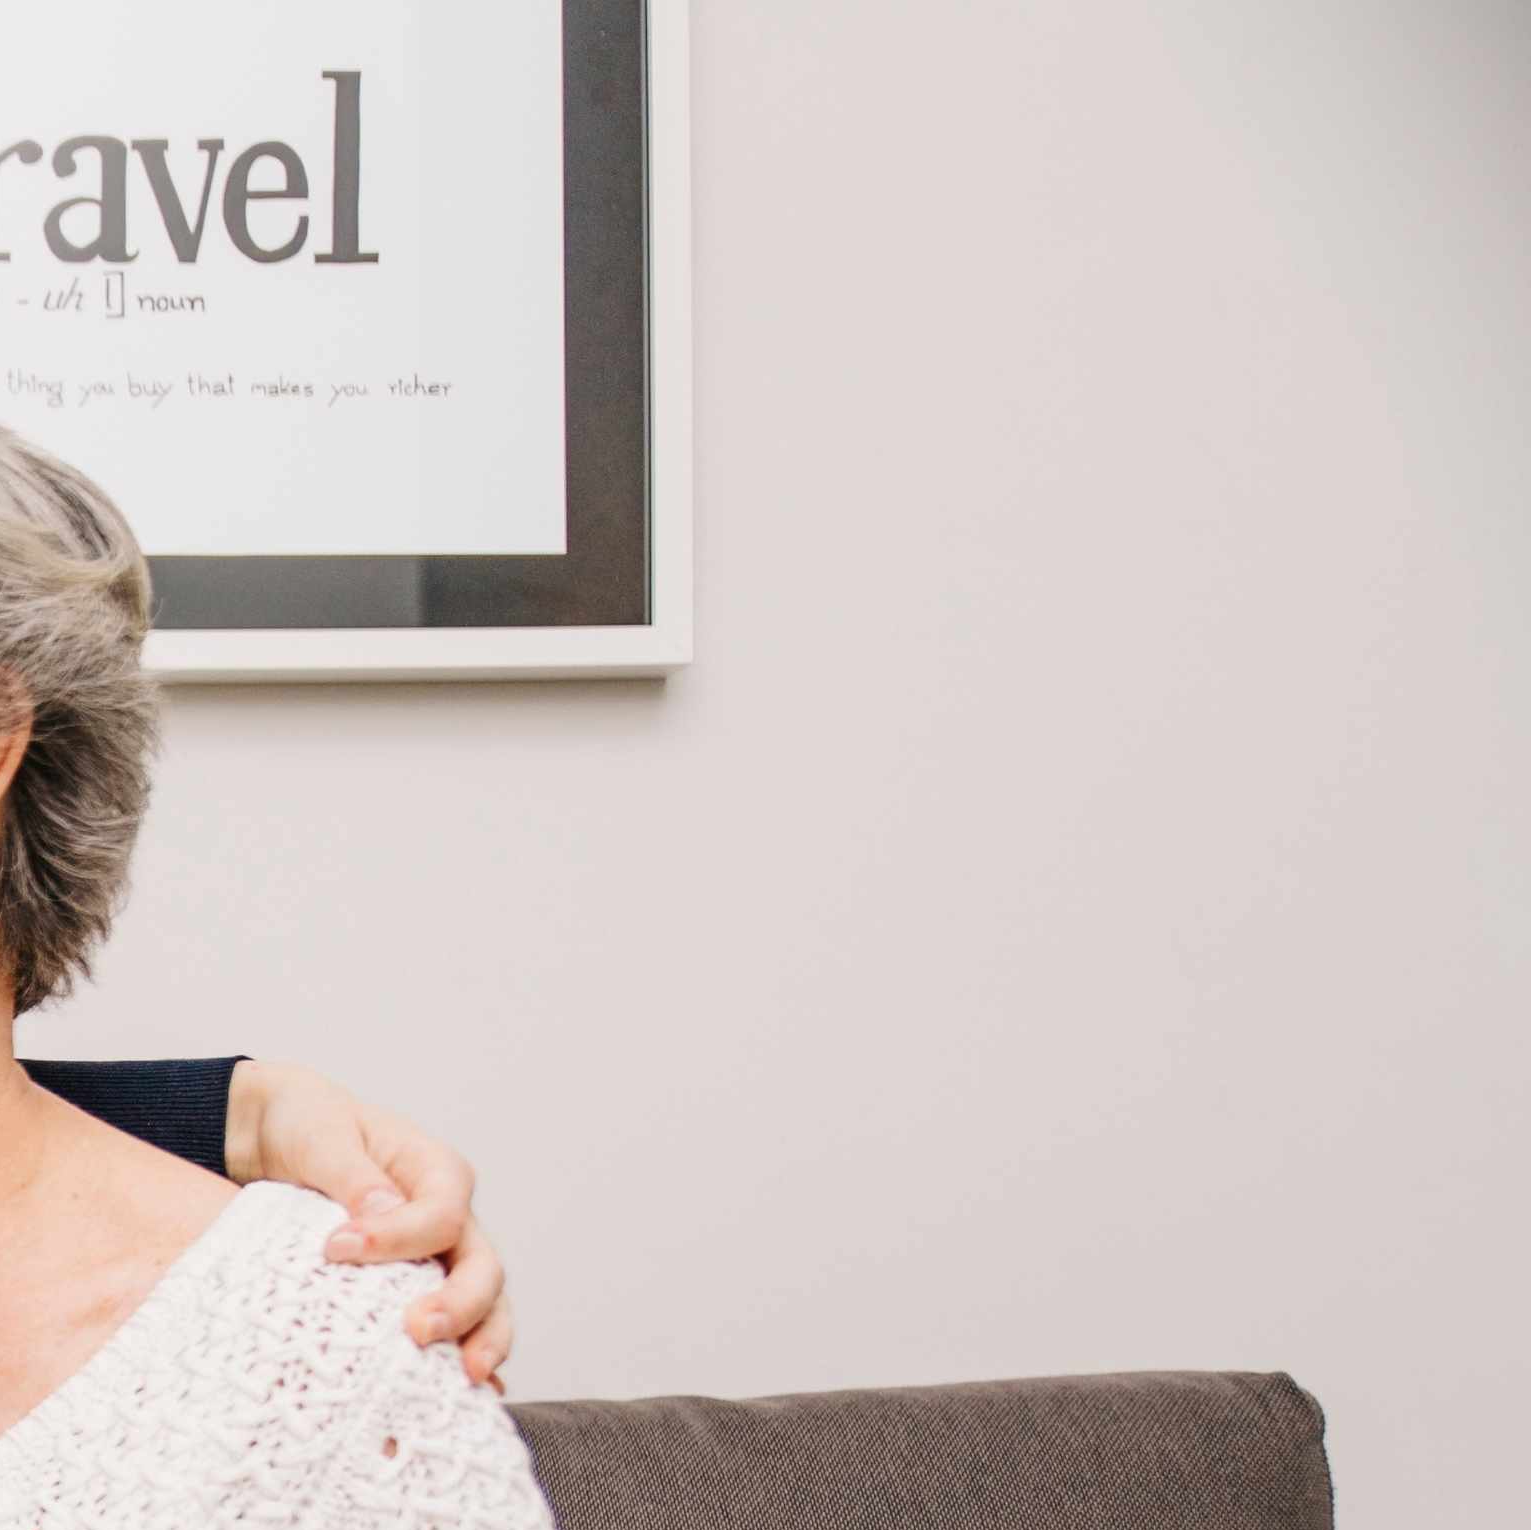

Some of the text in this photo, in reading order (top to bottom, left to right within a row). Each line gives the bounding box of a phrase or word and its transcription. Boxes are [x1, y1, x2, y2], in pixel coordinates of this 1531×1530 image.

[136, 292, 207, 314] noun
[6, 367, 66, 409] thing
[77, 378, 115, 409] you
[126, 370, 174, 410] buy
[186, 371, 236, 397] that
[250, 373, 315, 398] makes
[328, 383, 370, 409] you
[386, 371, 454, 398] richer
